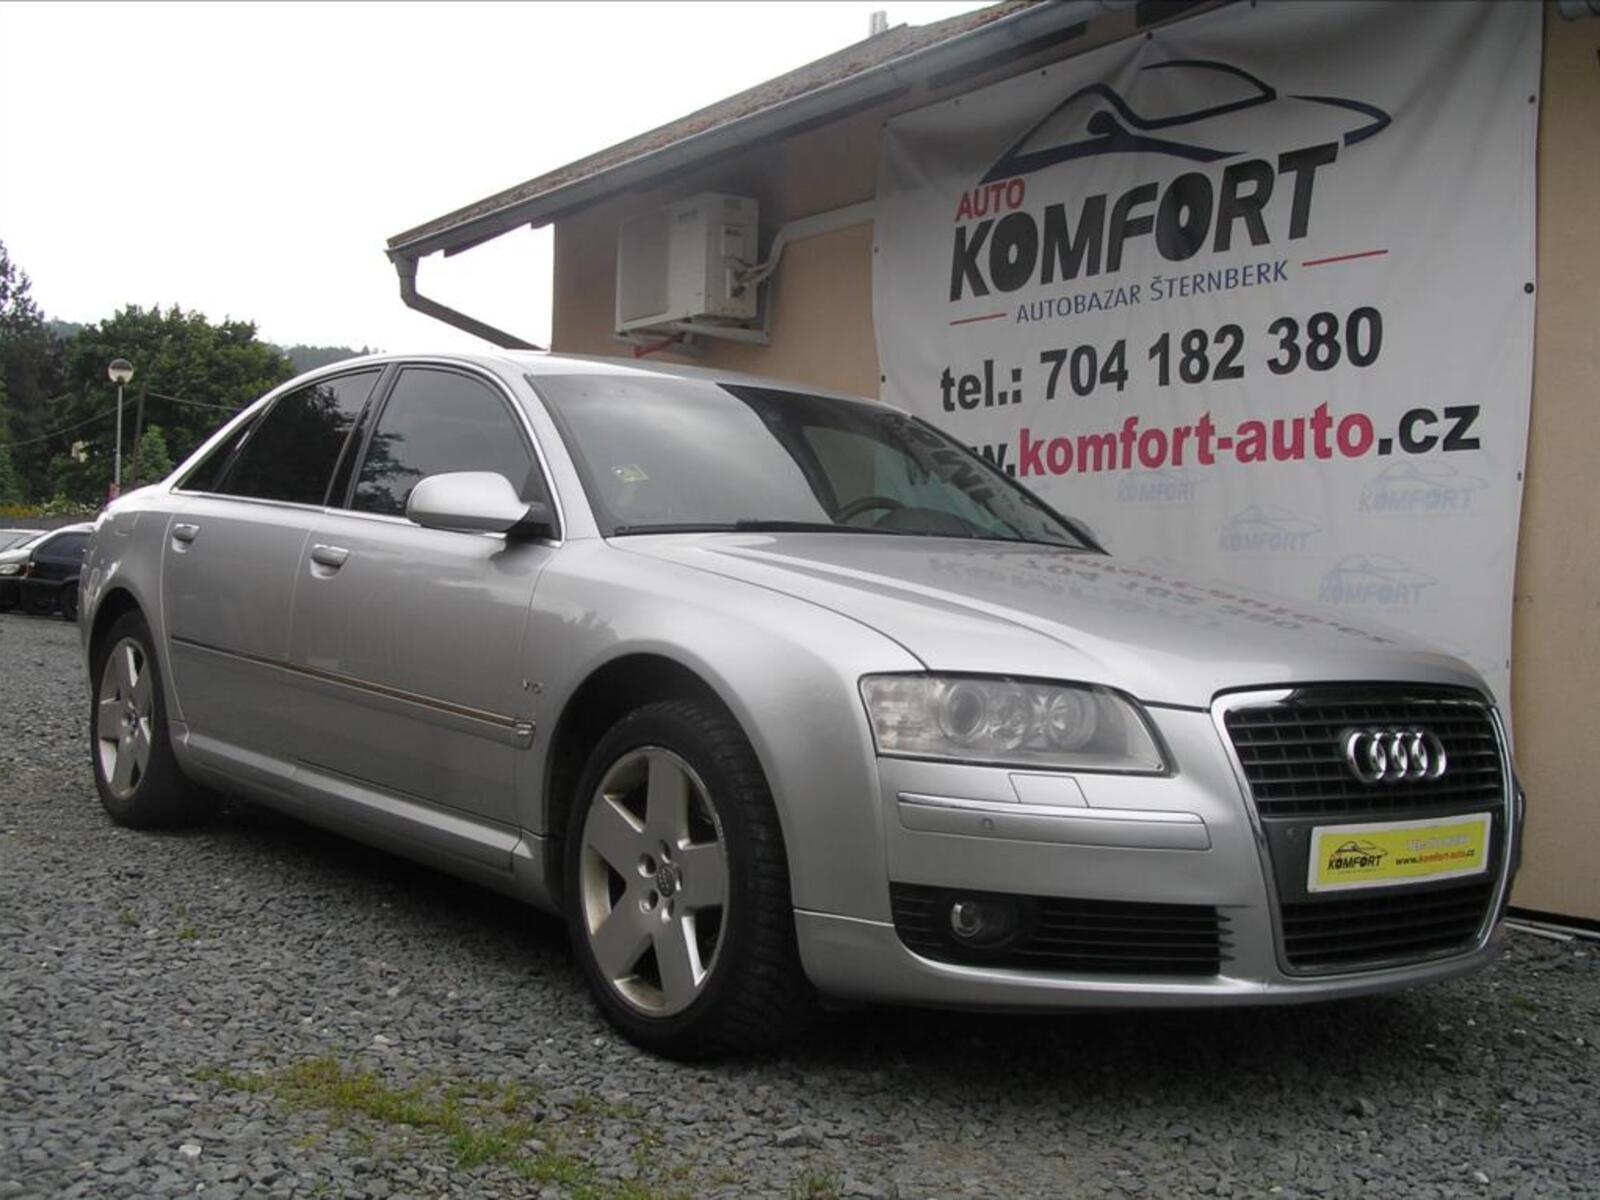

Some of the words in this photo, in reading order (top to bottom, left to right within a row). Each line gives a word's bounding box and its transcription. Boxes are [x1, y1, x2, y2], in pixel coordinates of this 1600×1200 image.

[955, 177, 1026, 222] AUTO
[949, 141, 1340, 303] KOMFORT
[1016, 284, 1141, 325] AUTOBAZAR
[1149, 259, 1289, 302] ŠTERNBERK
[940, 358, 1022, 413] tel.:
[1039, 338, 1129, 400] 704
[1148, 323, 1246, 387] 182
[1266, 306, 1384, 376] 380
[1116, 478, 1198, 502] KOMFORT
[1358, 487, 1475, 513] KOMFORT
[1217, 531, 1312, 554] KOMFORT
[1318, 580, 1427, 604] KOMFORT
[1327, 854, 1383, 871] KOMFORT
